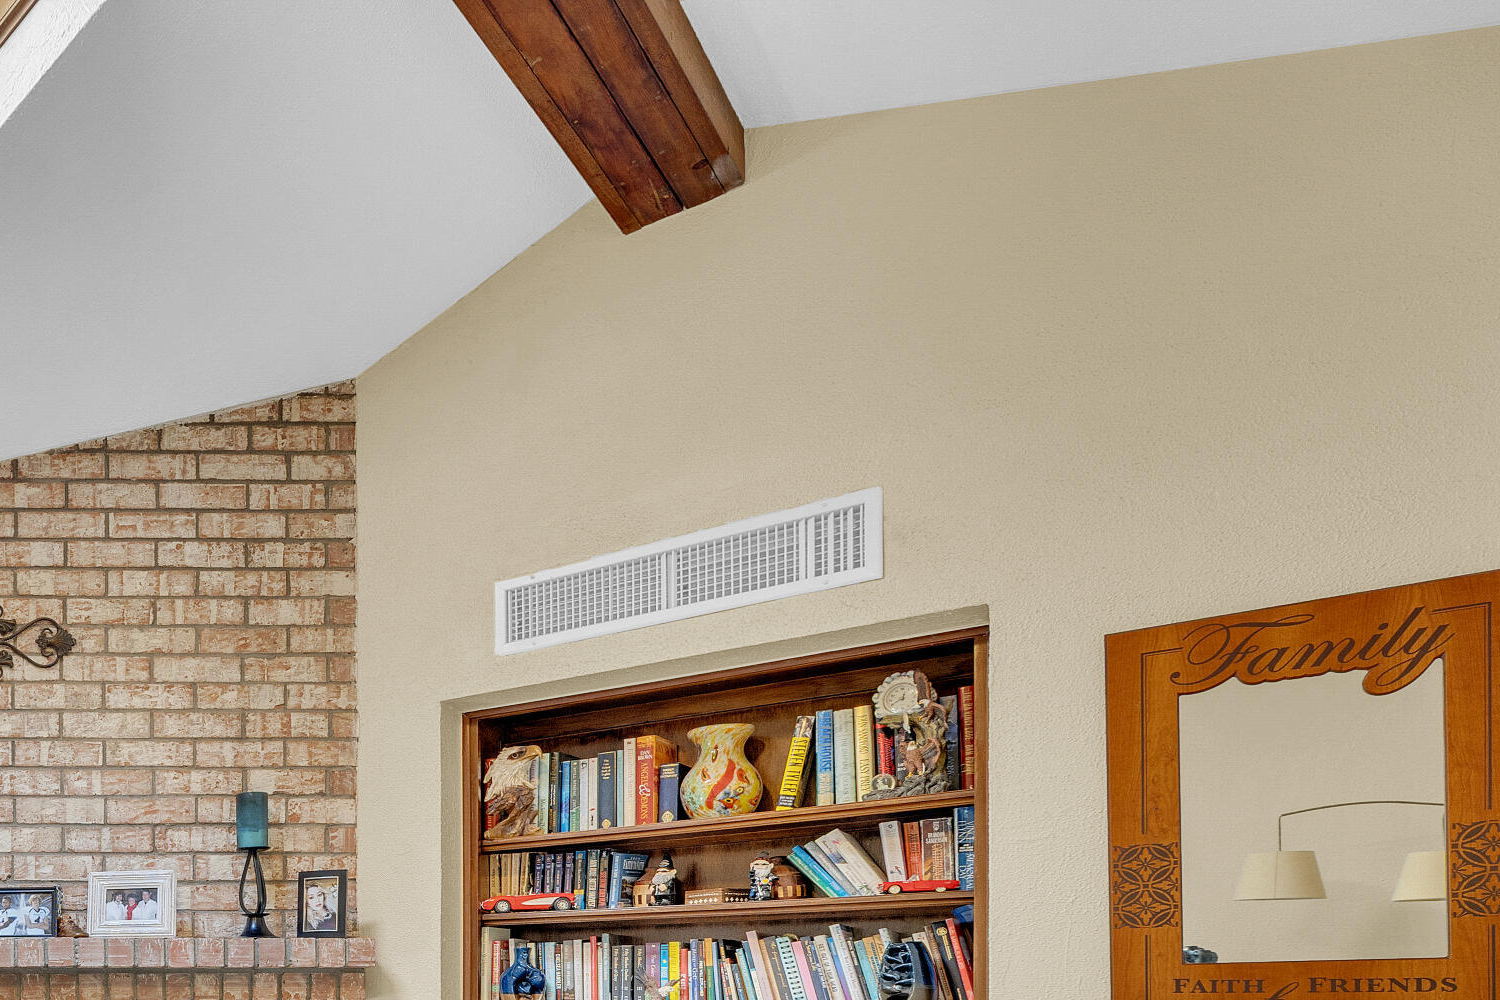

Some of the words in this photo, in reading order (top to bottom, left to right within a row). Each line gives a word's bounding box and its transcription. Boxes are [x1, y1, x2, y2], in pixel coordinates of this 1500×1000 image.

[1169, 606, 1456, 687] Family
[788, 738, 807, 767] STEVEN
[819, 745, 832, 772] HOUSE
[640, 762, 649, 787] ANGELS
[782, 766, 801, 793] TYLER
[1172, 977, 1265, 994] FAITH
[1308, 976, 1459, 993] FRIENDS
